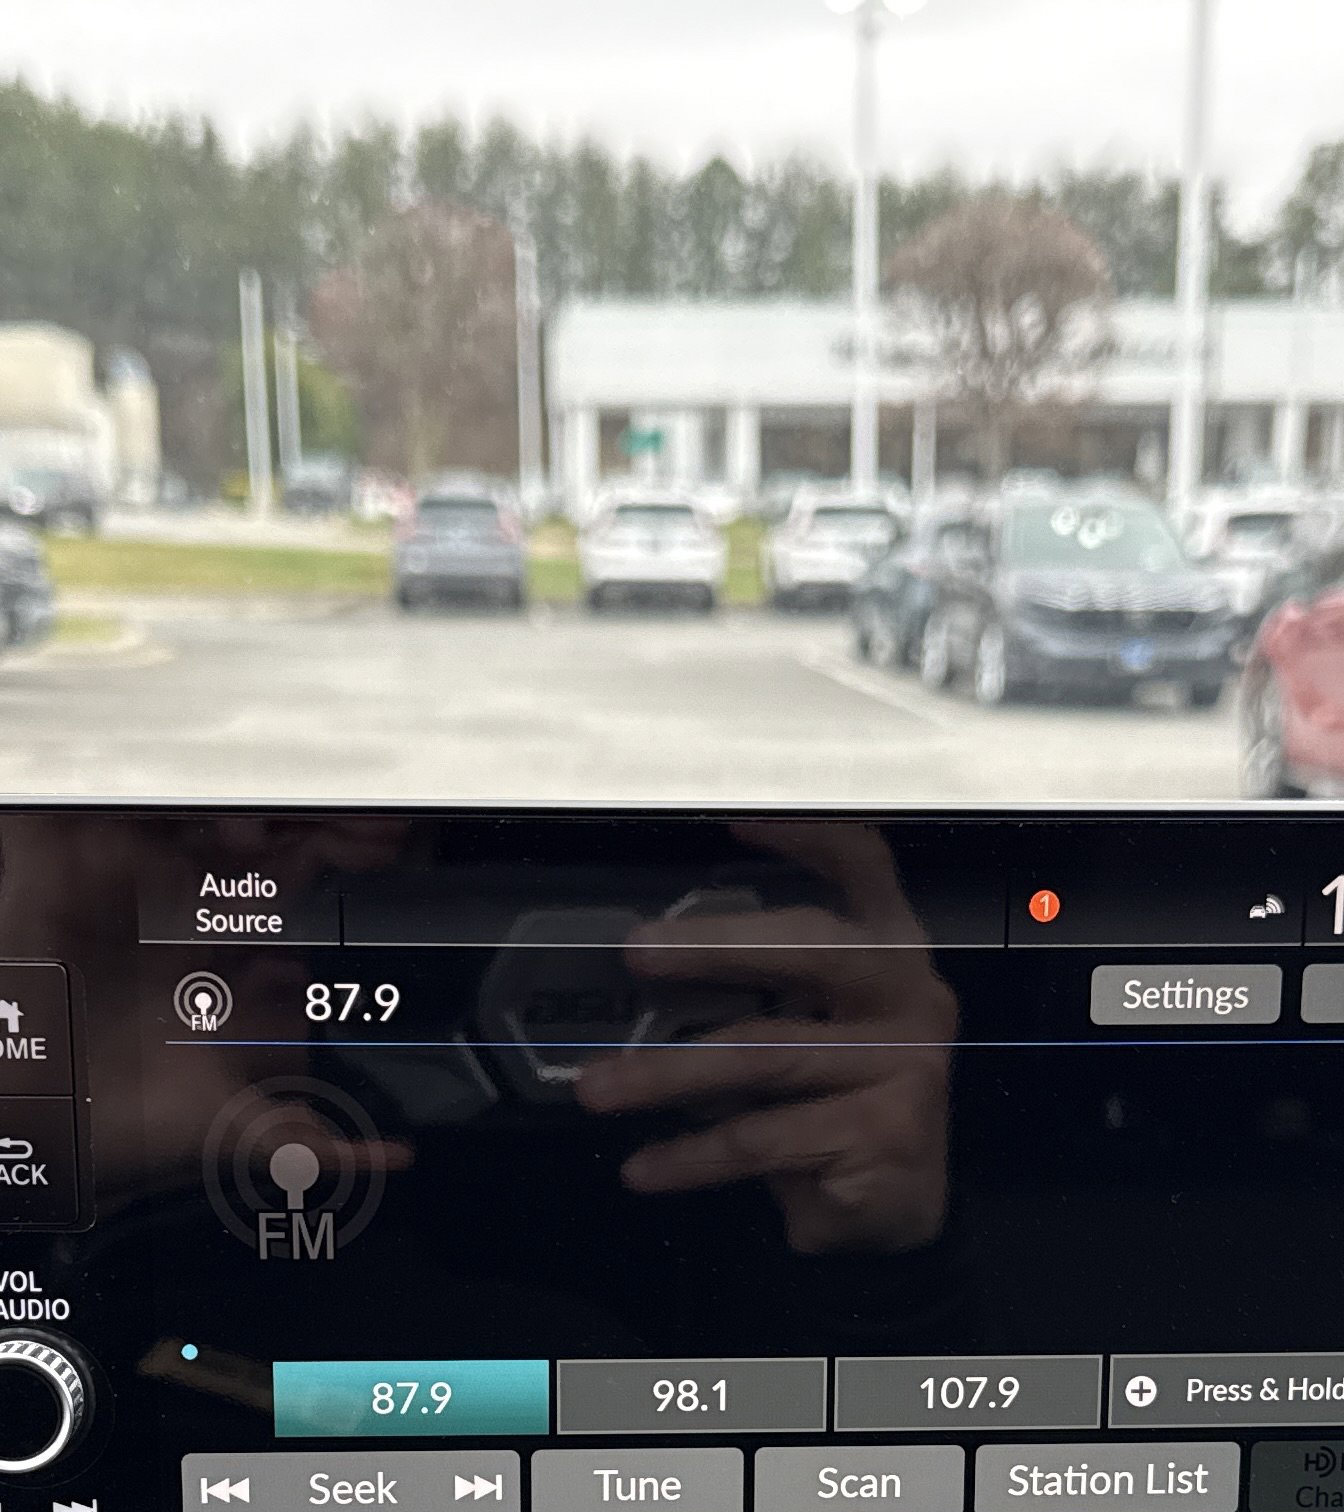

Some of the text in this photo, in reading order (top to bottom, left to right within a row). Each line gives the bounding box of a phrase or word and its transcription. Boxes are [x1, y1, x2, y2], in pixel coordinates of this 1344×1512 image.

[199, 872, 278, 900] Audio
[195, 908, 284, 935] Source
[305, 983, 401, 1023] 87.9
[1122, 977, 1250, 1017] Settings
[190, 1015, 218, 1033] FM
[258, 1211, 337, 1260] FM
[371, 1381, 453, 1416] 87.9
[651, 1379, 729, 1414] 98.1
[918, 1375, 1021, 1411] 107.9
[1185, 1377, 1254, 1404] Press
[1258, 1377, 1280, 1402] &
[307, 1471, 399, 1506] Seek
[592, 1468, 683, 1503] Tune
[816, 1467, 903, 1501] Scan
[1007, 1461, 1209, 1498] Station List
